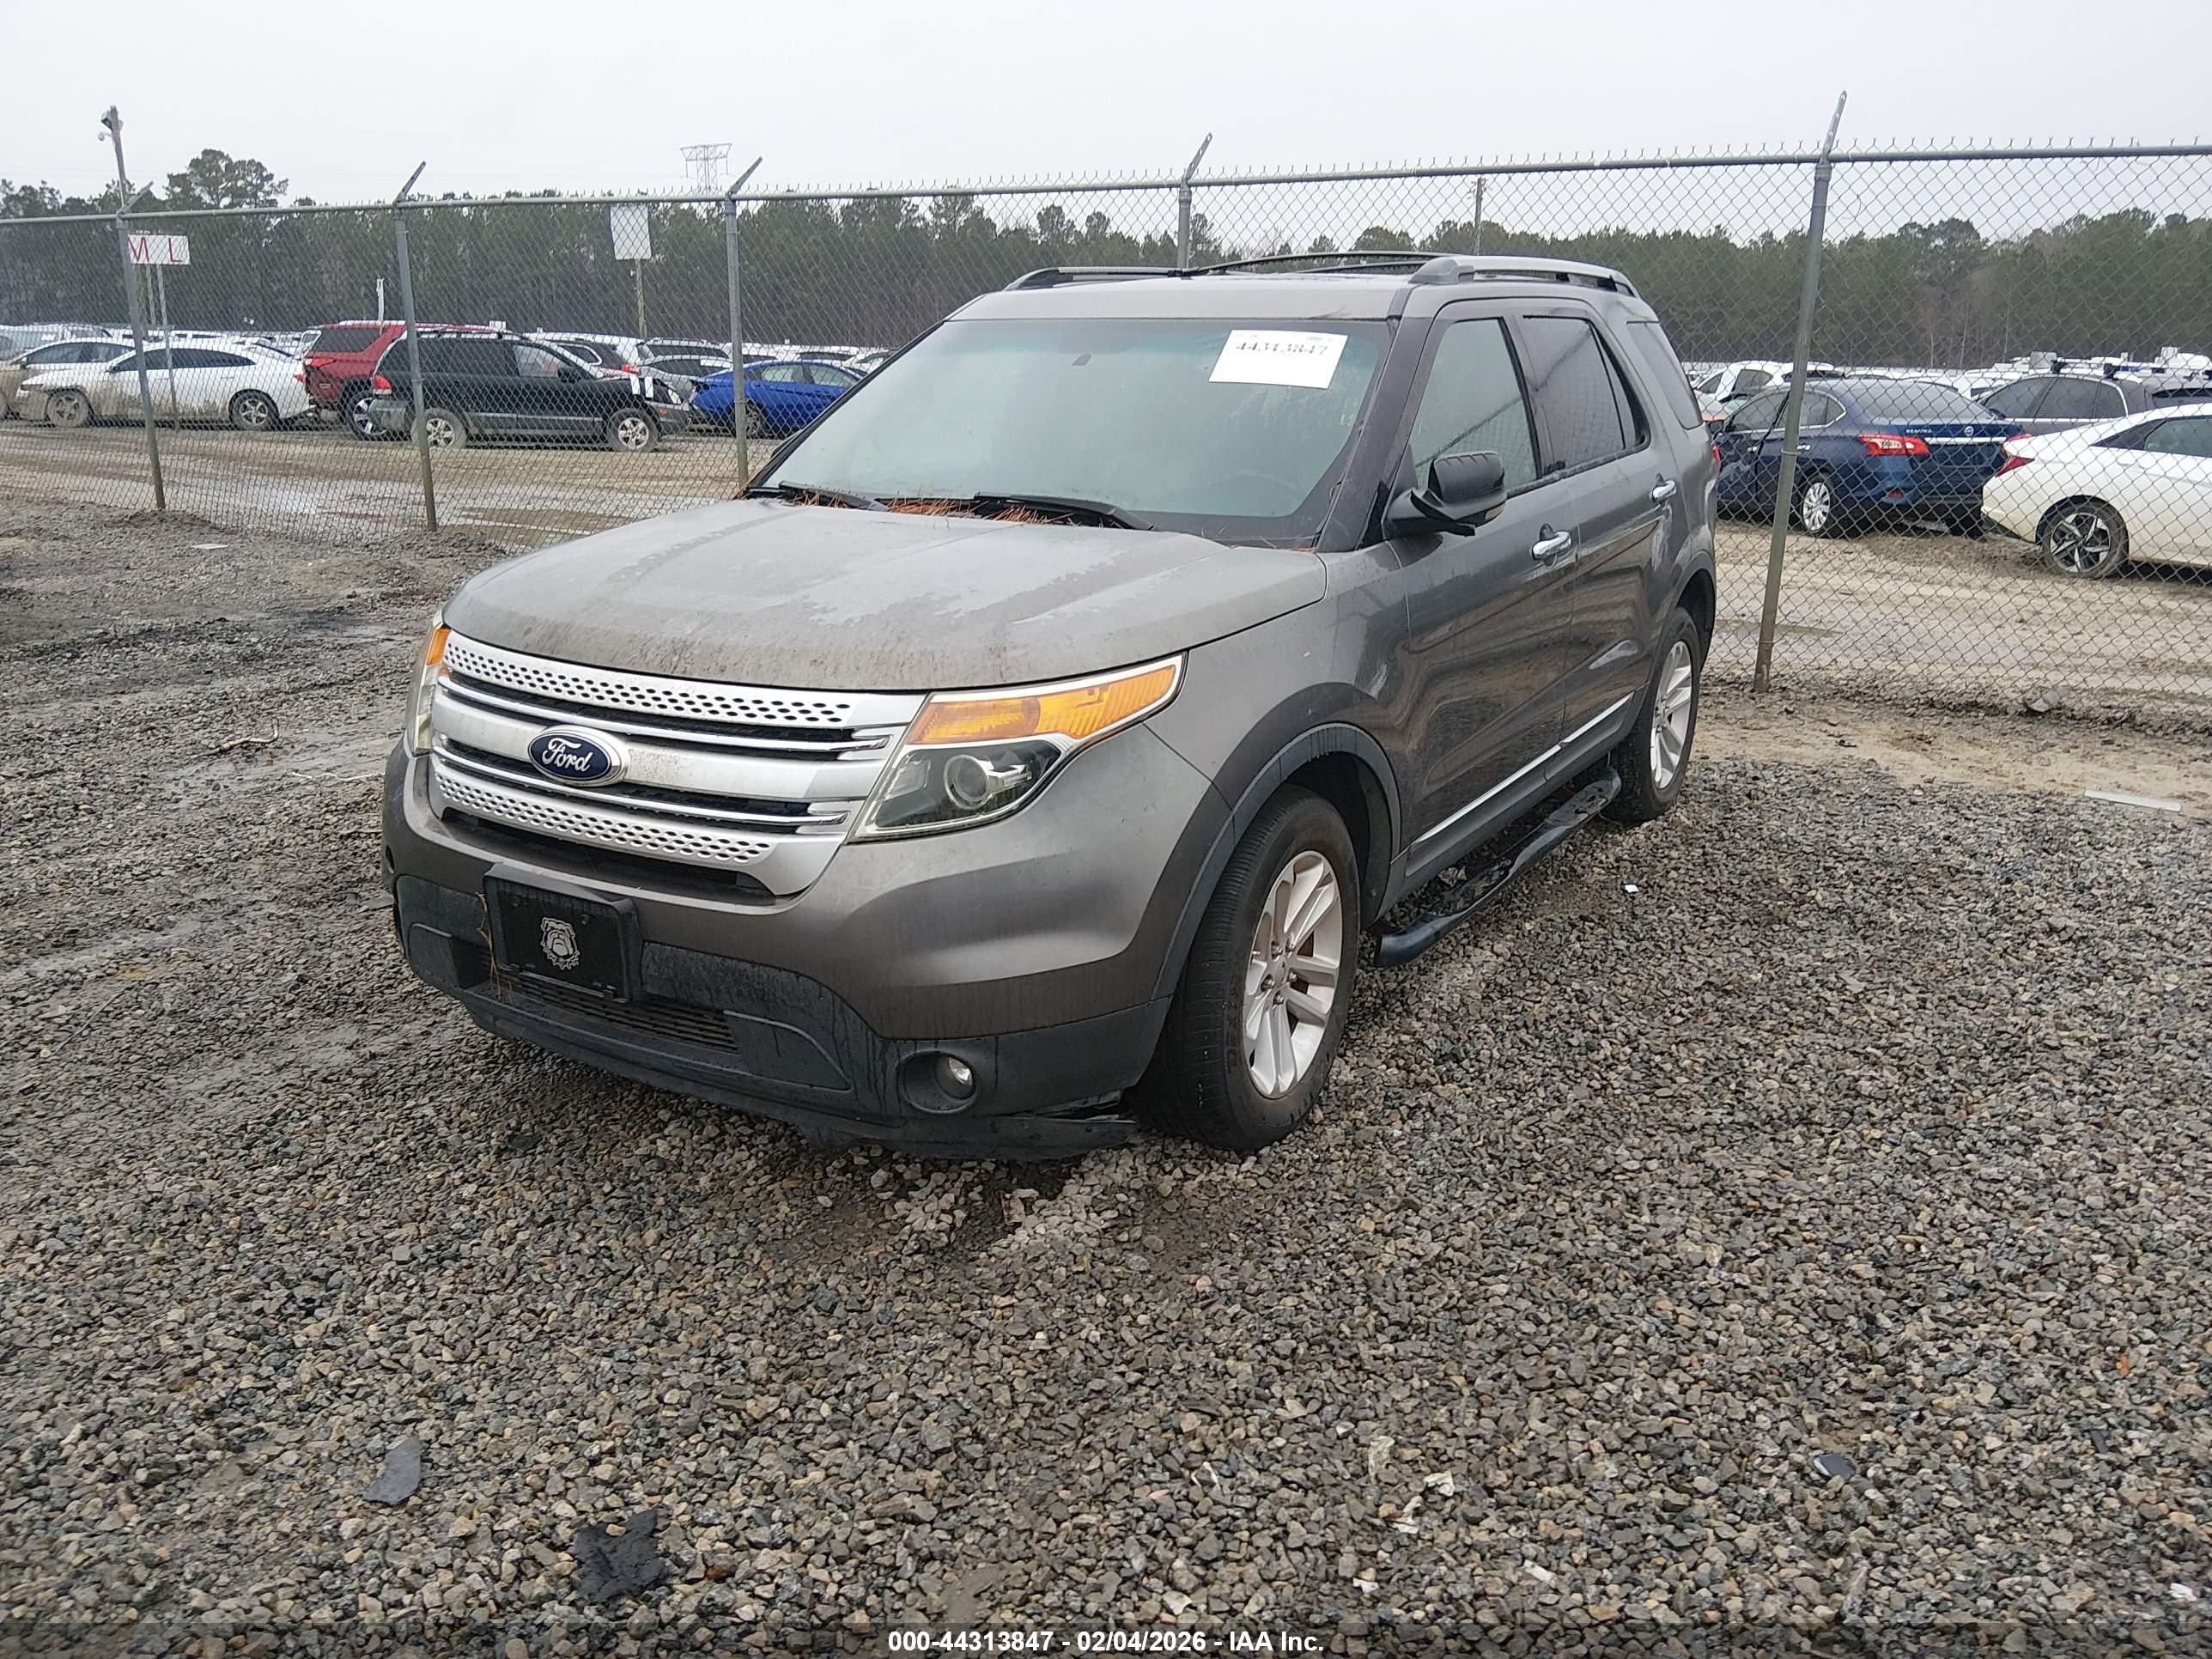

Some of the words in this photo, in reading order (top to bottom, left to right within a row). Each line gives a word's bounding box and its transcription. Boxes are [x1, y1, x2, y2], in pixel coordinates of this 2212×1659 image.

[168, 237, 183, 262] L
[1236, 341, 1329, 356] 44313847
[542, 738, 593, 772] Ford
